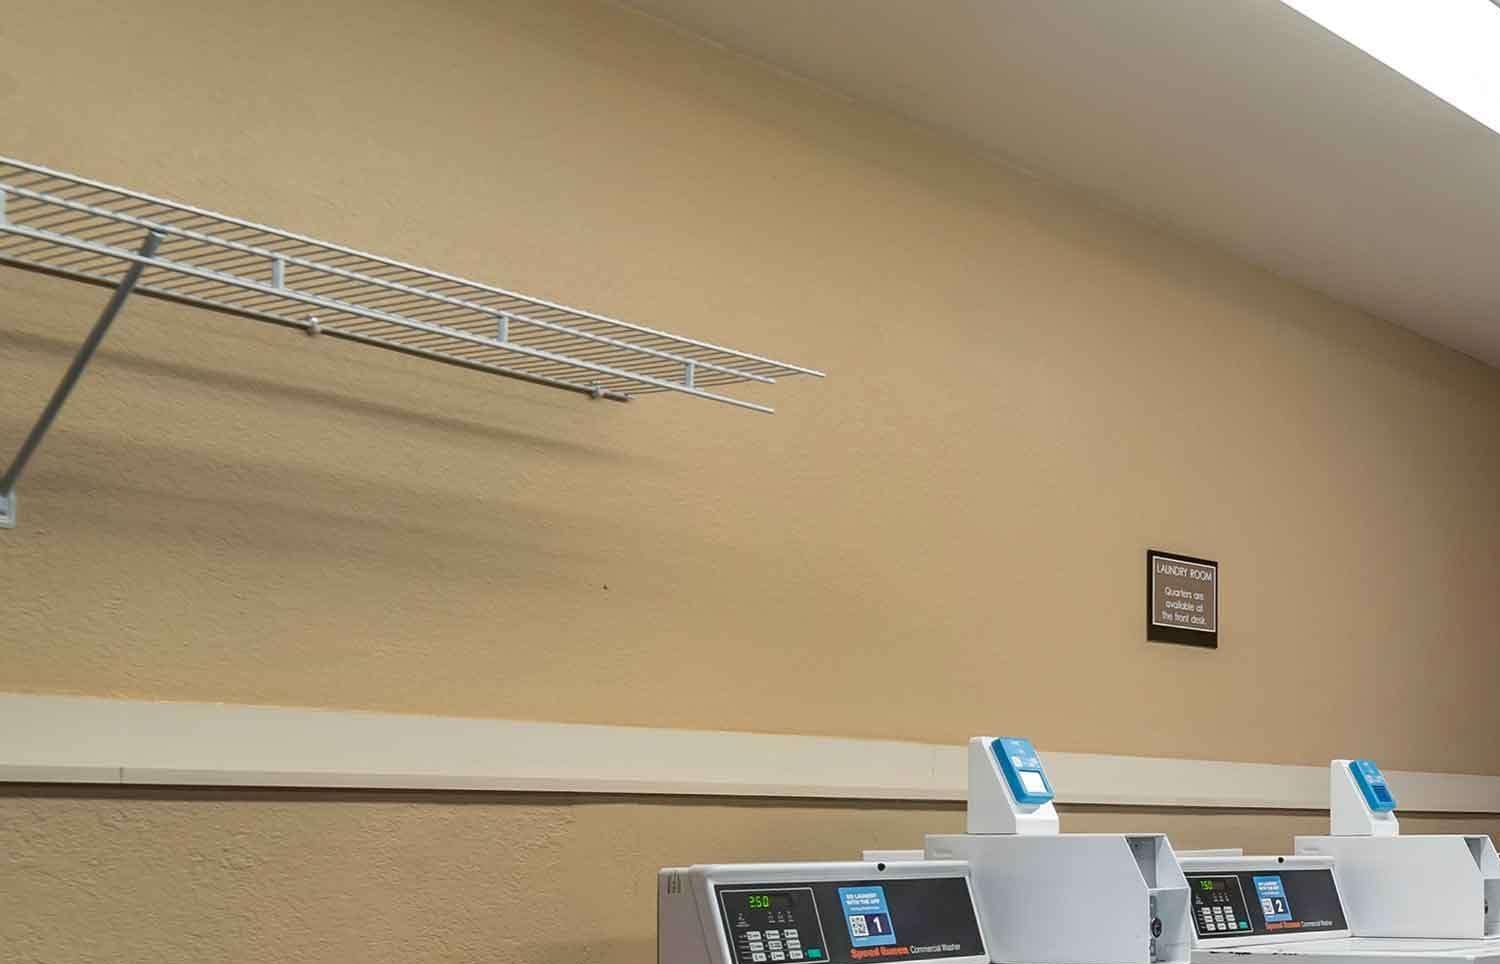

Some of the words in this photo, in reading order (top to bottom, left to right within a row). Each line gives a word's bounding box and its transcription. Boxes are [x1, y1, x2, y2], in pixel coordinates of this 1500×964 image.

[1157, 562, 1187, 577] LAUNDRY
[1190, 568, 1212, 581] ROOM
[1165, 586, 1192, 599] Quarters
[1165, 601, 1194, 611] available
[1196, 603, 1204, 612] at
[1162, 611, 1173, 620] the
[1174, 611, 1189, 622] front
[1275, 899, 1284, 912] 2
[873, 916, 882, 933] 1
[910, 945, 941, 954] Commercial
